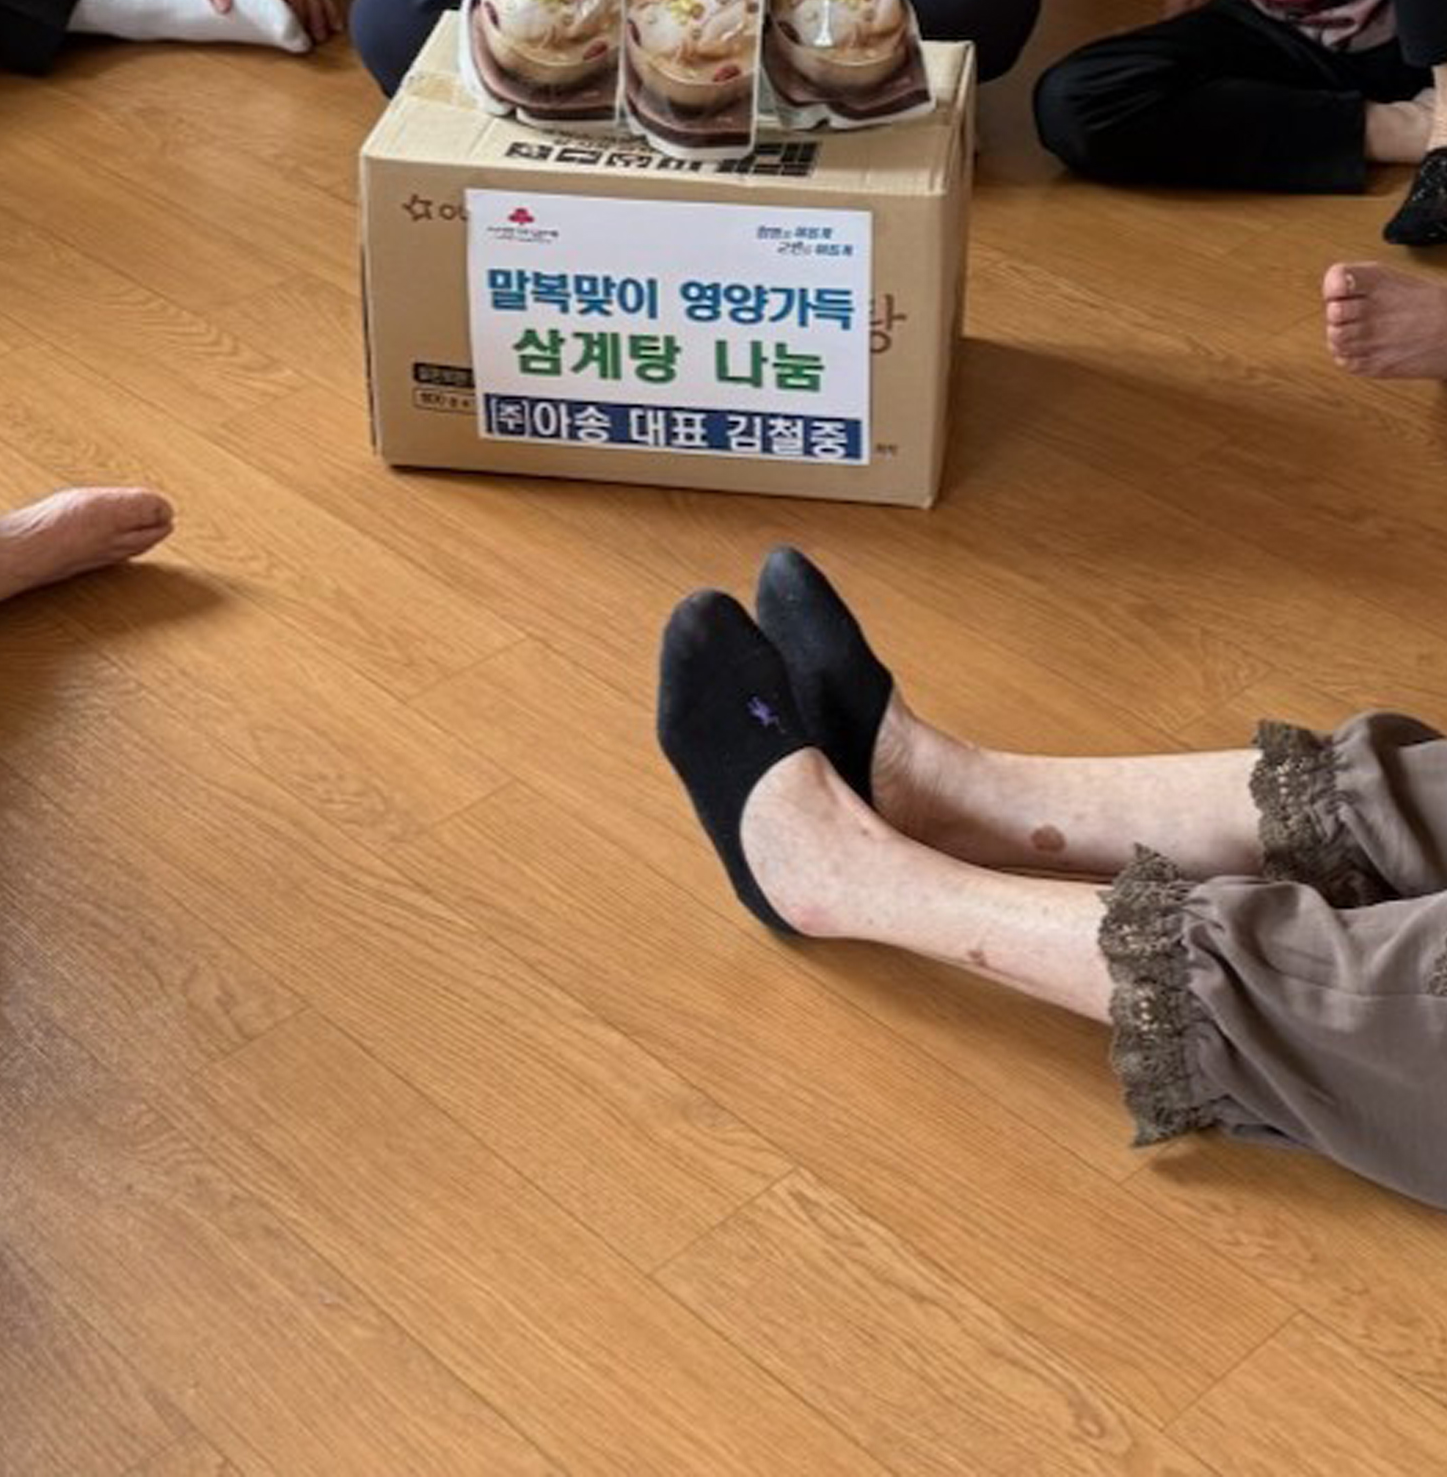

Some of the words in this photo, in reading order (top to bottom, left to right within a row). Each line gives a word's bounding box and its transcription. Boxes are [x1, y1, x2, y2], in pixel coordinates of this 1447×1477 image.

[487, 268, 659, 320] 말복맞이
[679, 280, 855, 330] 영양가득
[512, 328, 682, 384] 삼계탕
[714, 339, 825, 393] 나눔
[628, 408, 709, 449] 대표
[726, 413, 849, 460] 김철중
